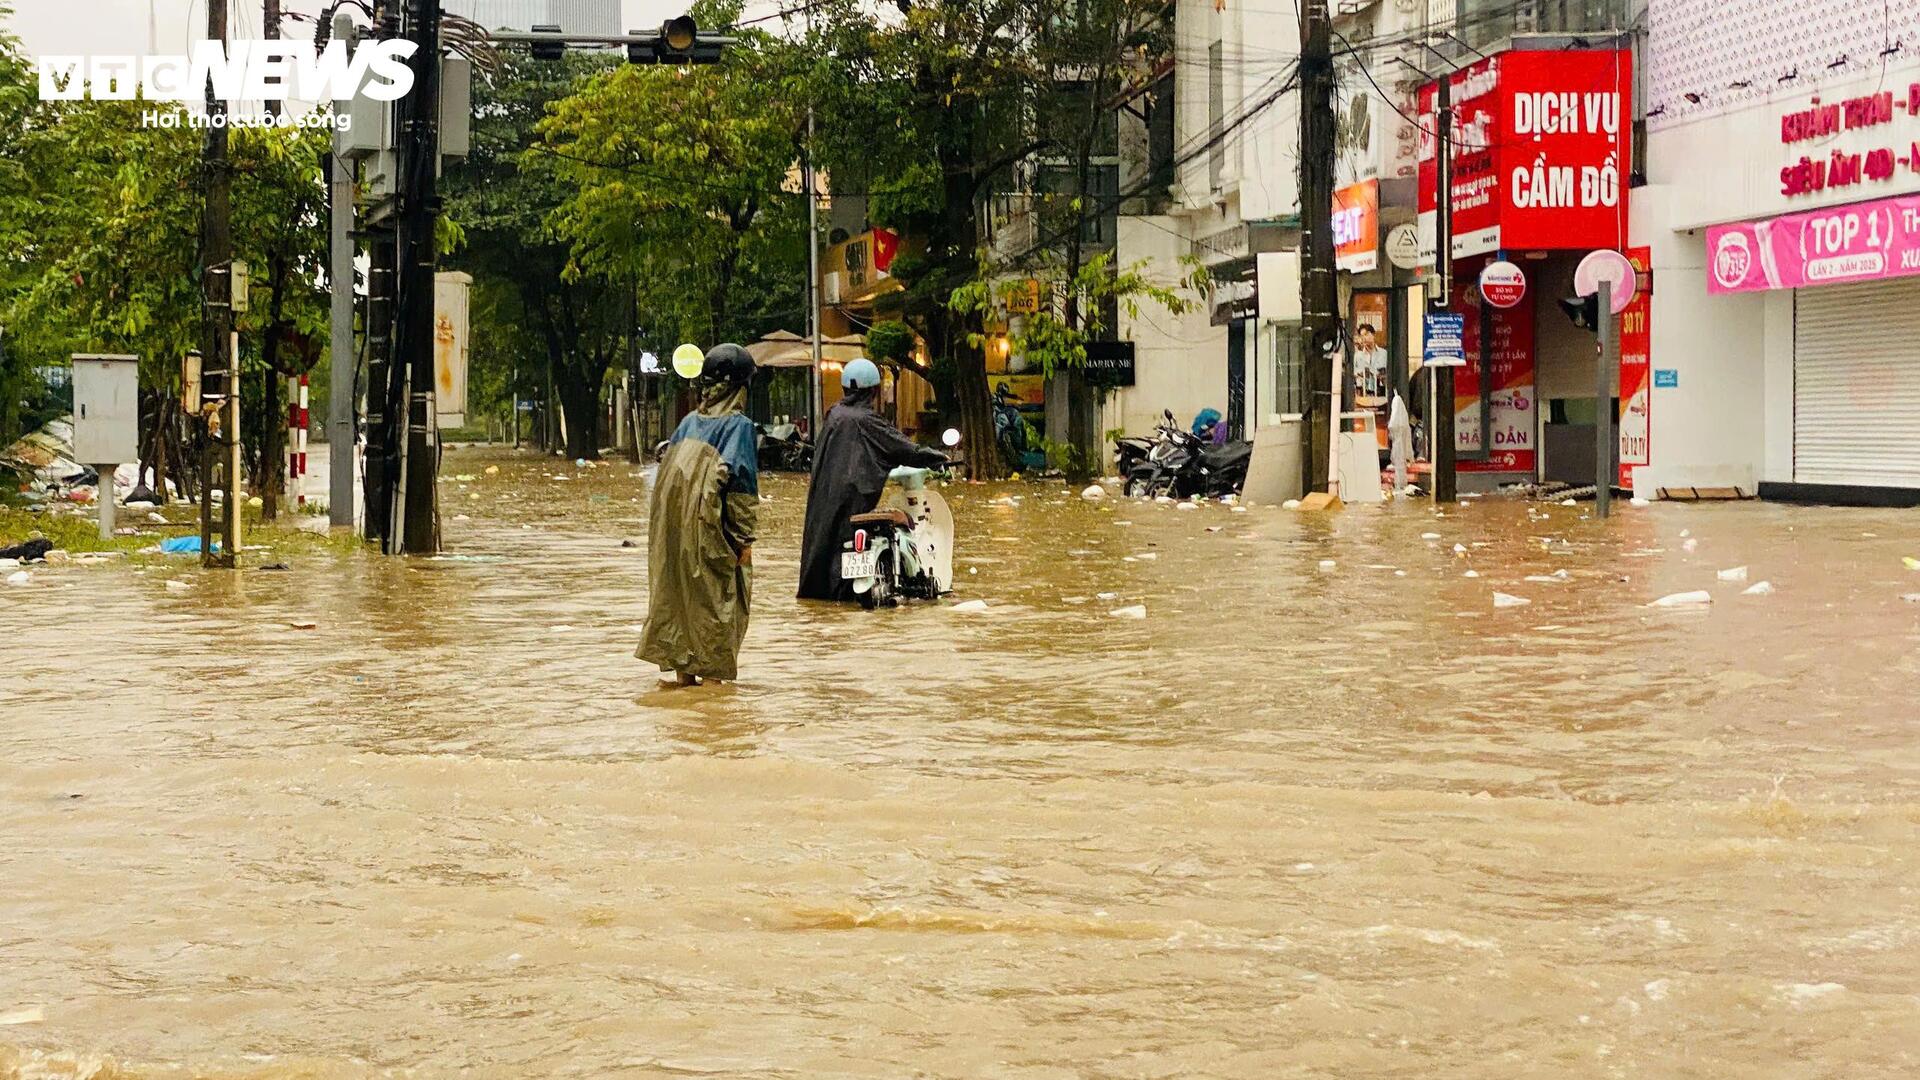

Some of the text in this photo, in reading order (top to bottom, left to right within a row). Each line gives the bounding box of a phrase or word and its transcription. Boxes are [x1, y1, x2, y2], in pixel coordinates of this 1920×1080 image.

[1514, 92, 1578, 142] DỊCH
[1584, 92, 1619, 142] VỤ
[1512, 151, 1619, 208] CẦM ĐỒ
[1810, 209, 1880, 254] TOP 1
[1623, 311, 1633, 334] 30
